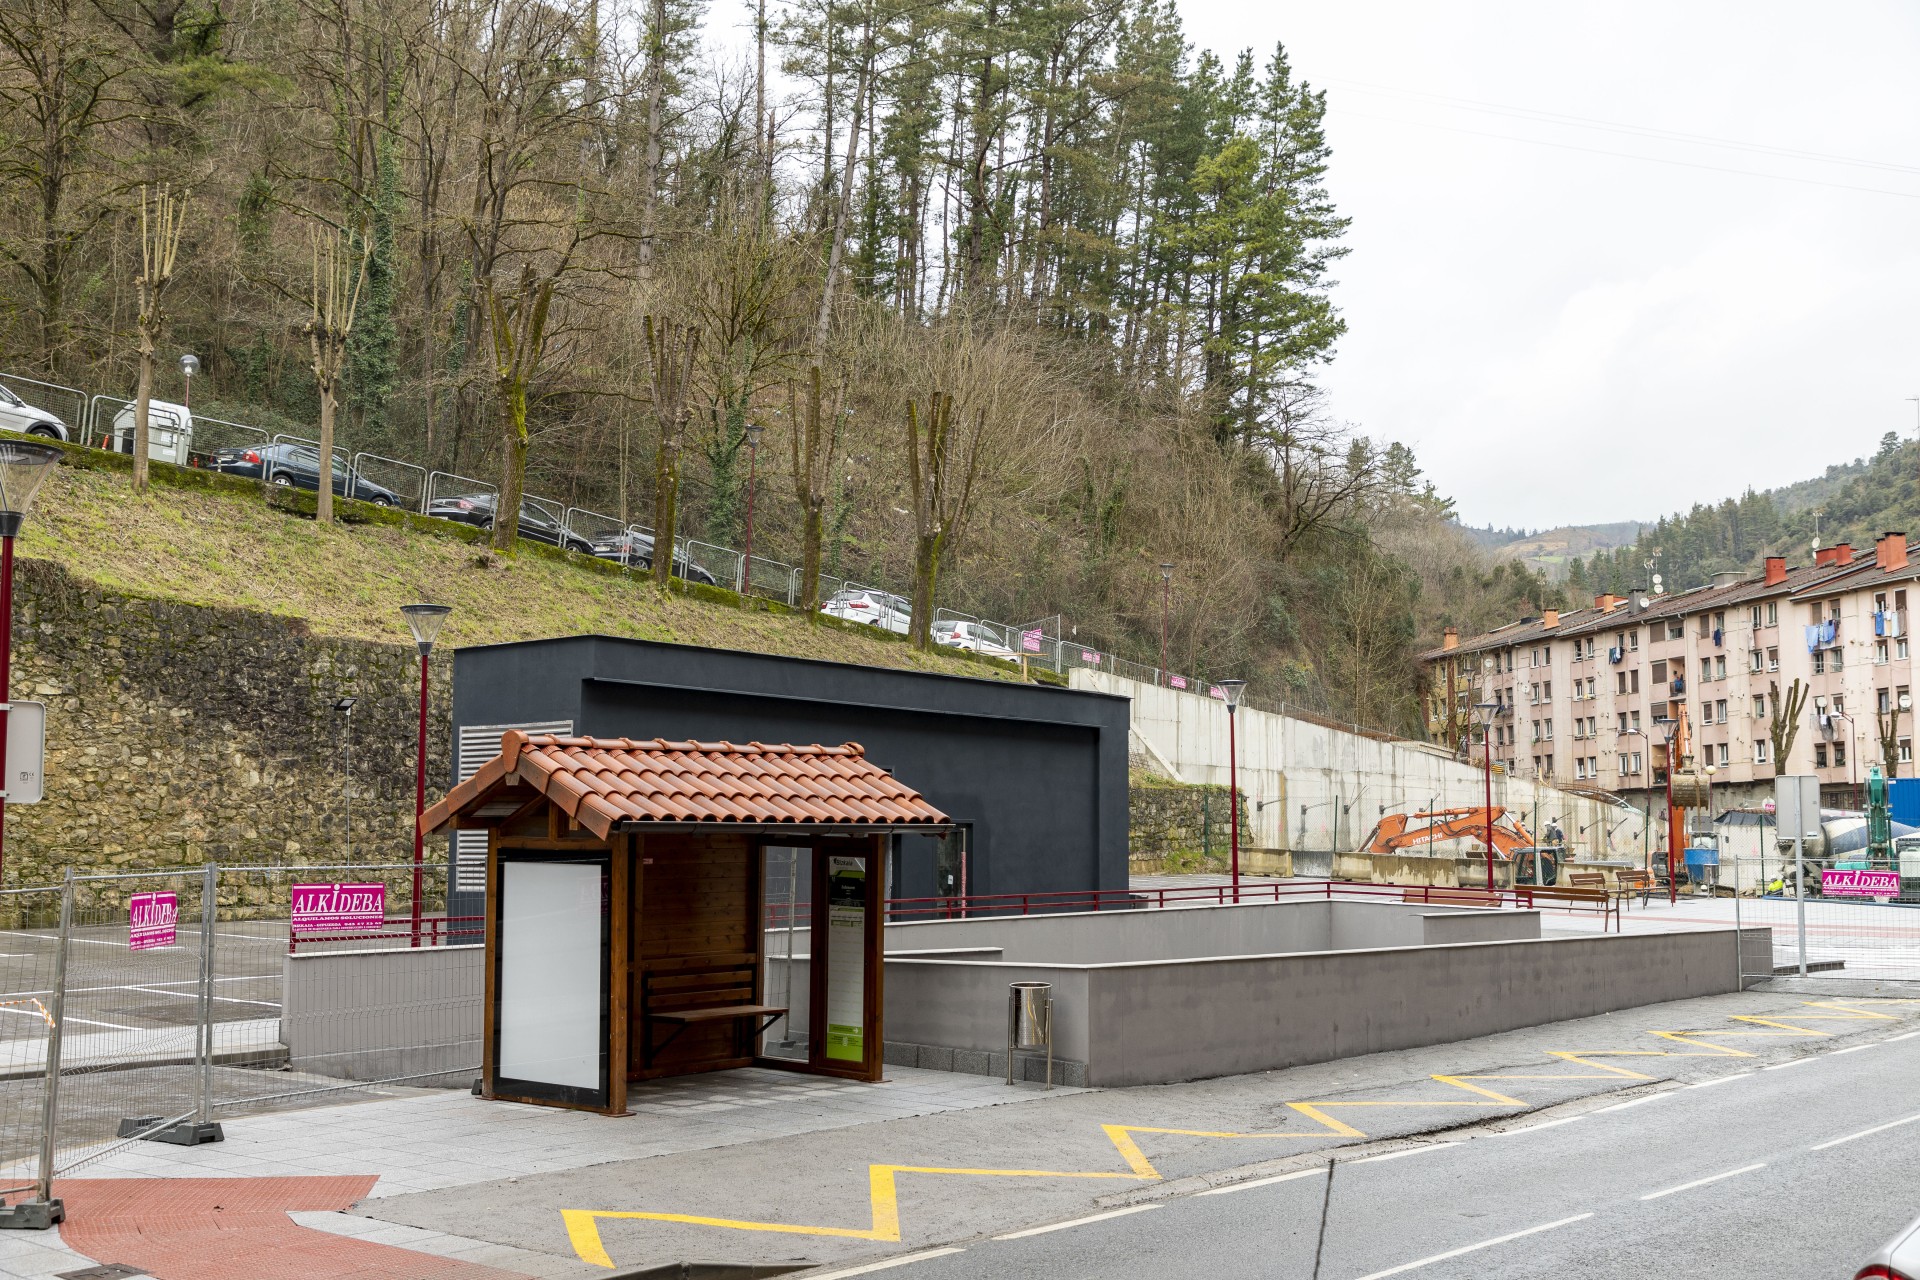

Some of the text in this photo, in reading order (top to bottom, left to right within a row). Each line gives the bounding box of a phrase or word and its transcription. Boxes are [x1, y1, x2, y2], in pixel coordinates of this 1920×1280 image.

[1412, 833, 1443, 845] HITACHI
[1823, 870, 1898, 889] ALKIDEBA
[131, 893, 178, 928] ALKIDEBA
[293, 884, 383, 913] ALKIDEBA
